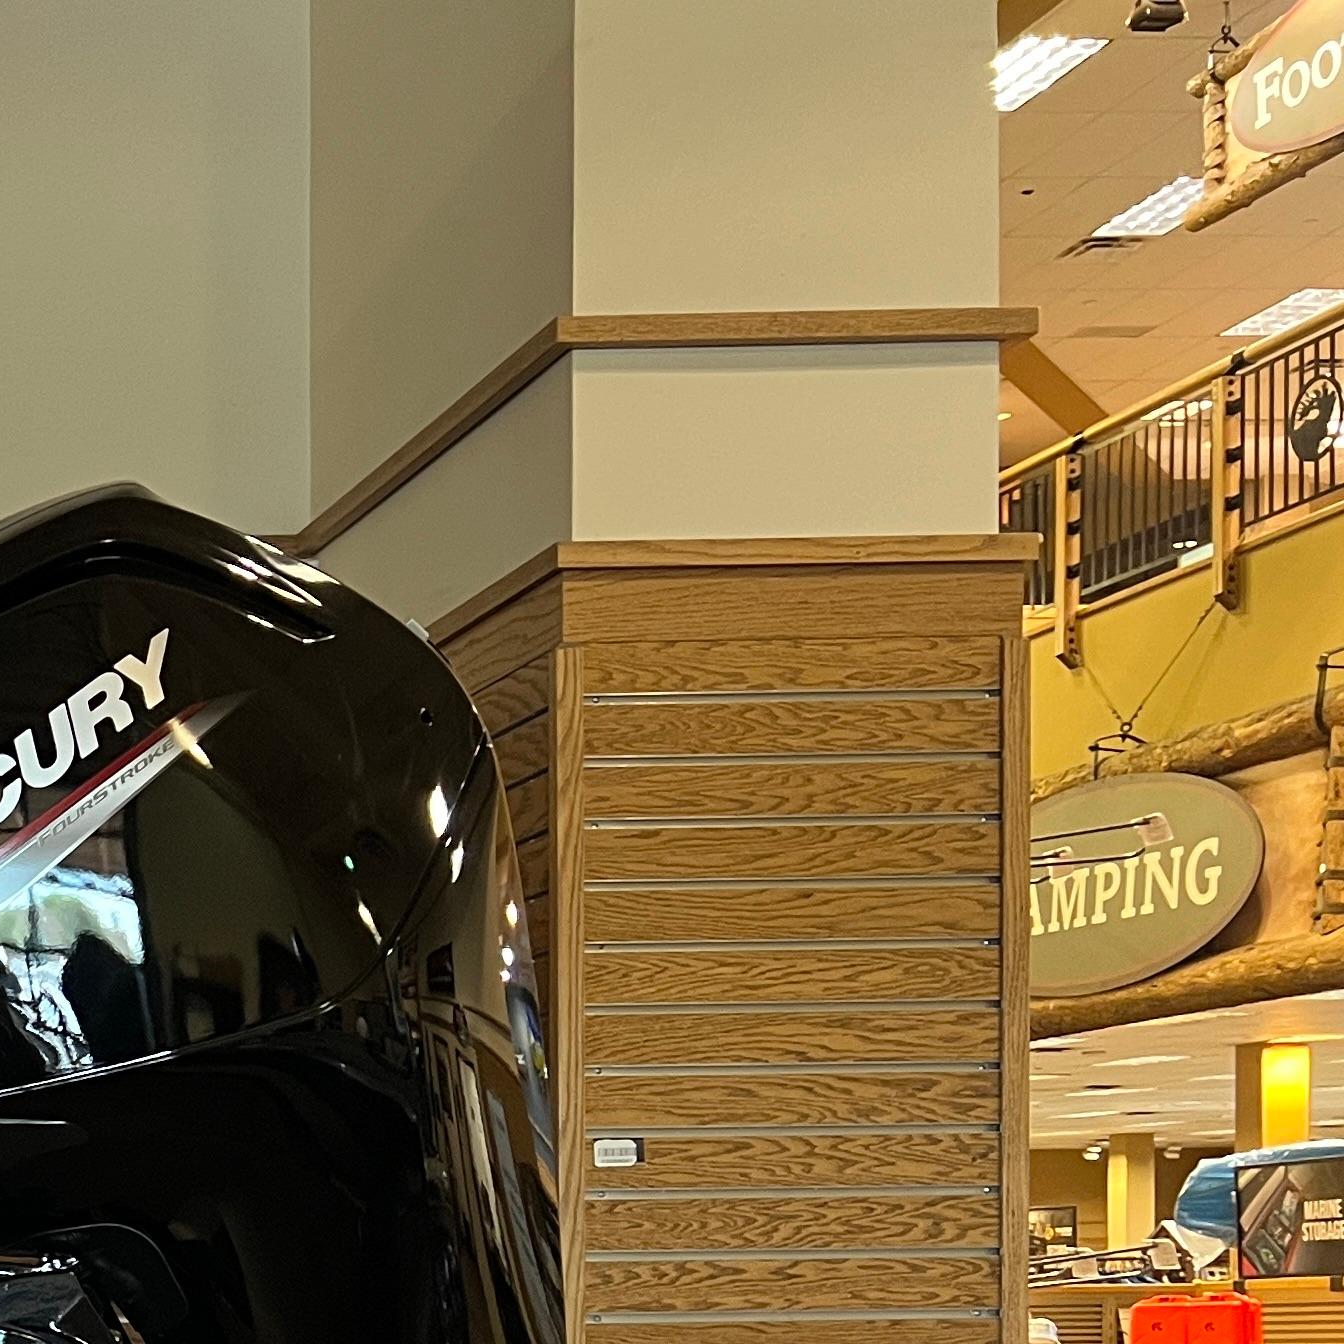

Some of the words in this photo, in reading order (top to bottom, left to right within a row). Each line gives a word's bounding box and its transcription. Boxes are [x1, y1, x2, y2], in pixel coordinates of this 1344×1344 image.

[1253, 32, 1344, 129] Foo
[37, 739, 175, 848] FOURSTROKE
[1303, 1198, 1343, 1220] MARINE
